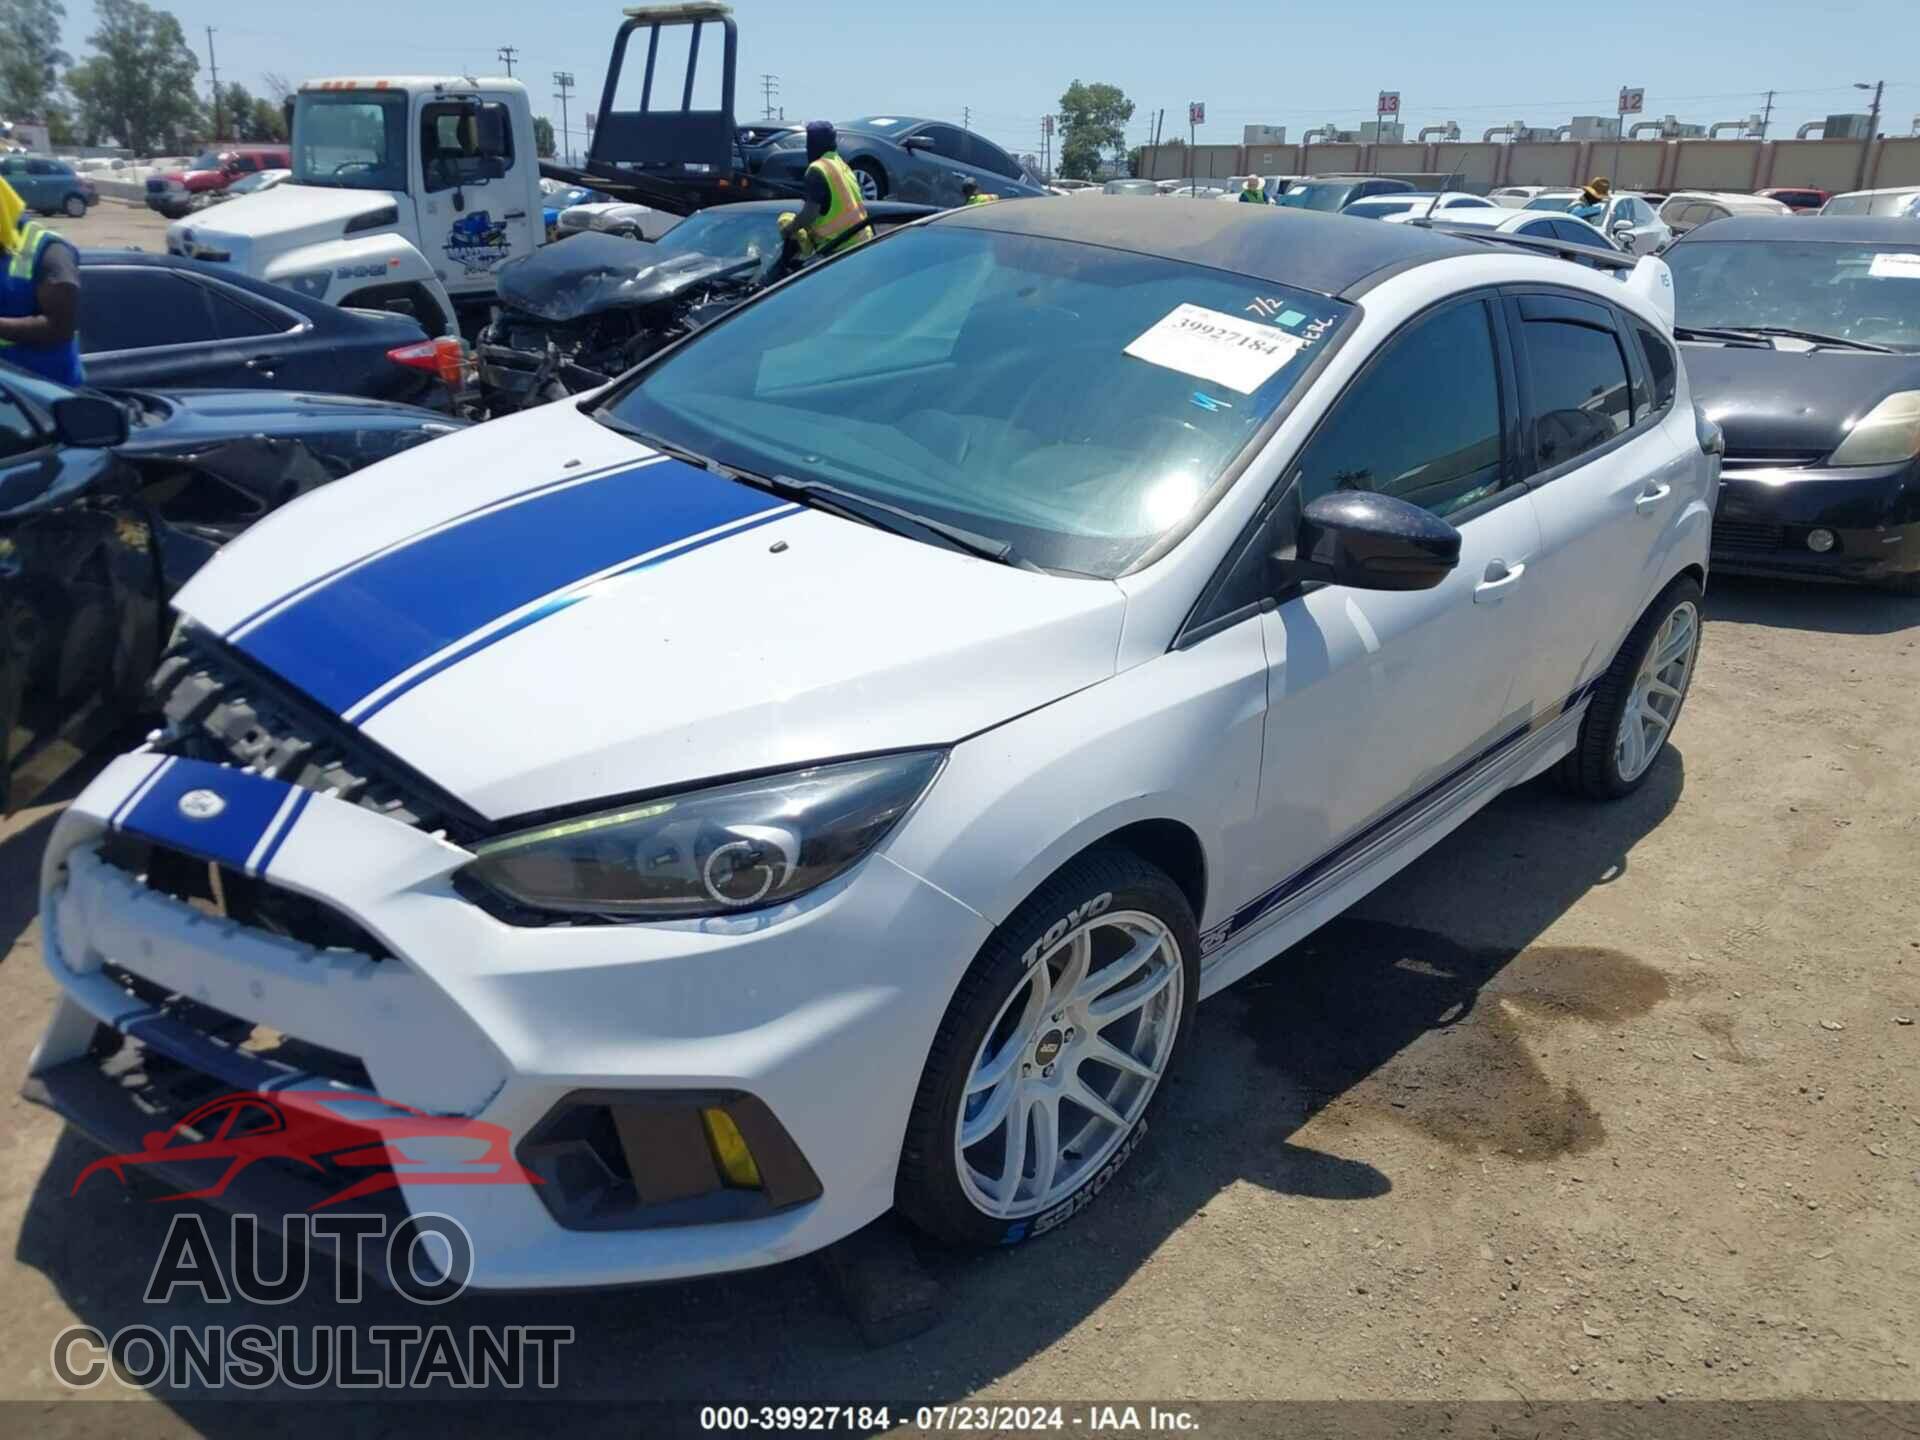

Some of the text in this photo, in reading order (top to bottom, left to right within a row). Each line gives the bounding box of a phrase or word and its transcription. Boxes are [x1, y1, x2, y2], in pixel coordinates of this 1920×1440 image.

[1378, 96, 1398, 111] 13
[1619, 94, 1642, 110] 12
[1172, 317, 1279, 355] 39927184
[1021, 892, 1113, 968] TOYO
